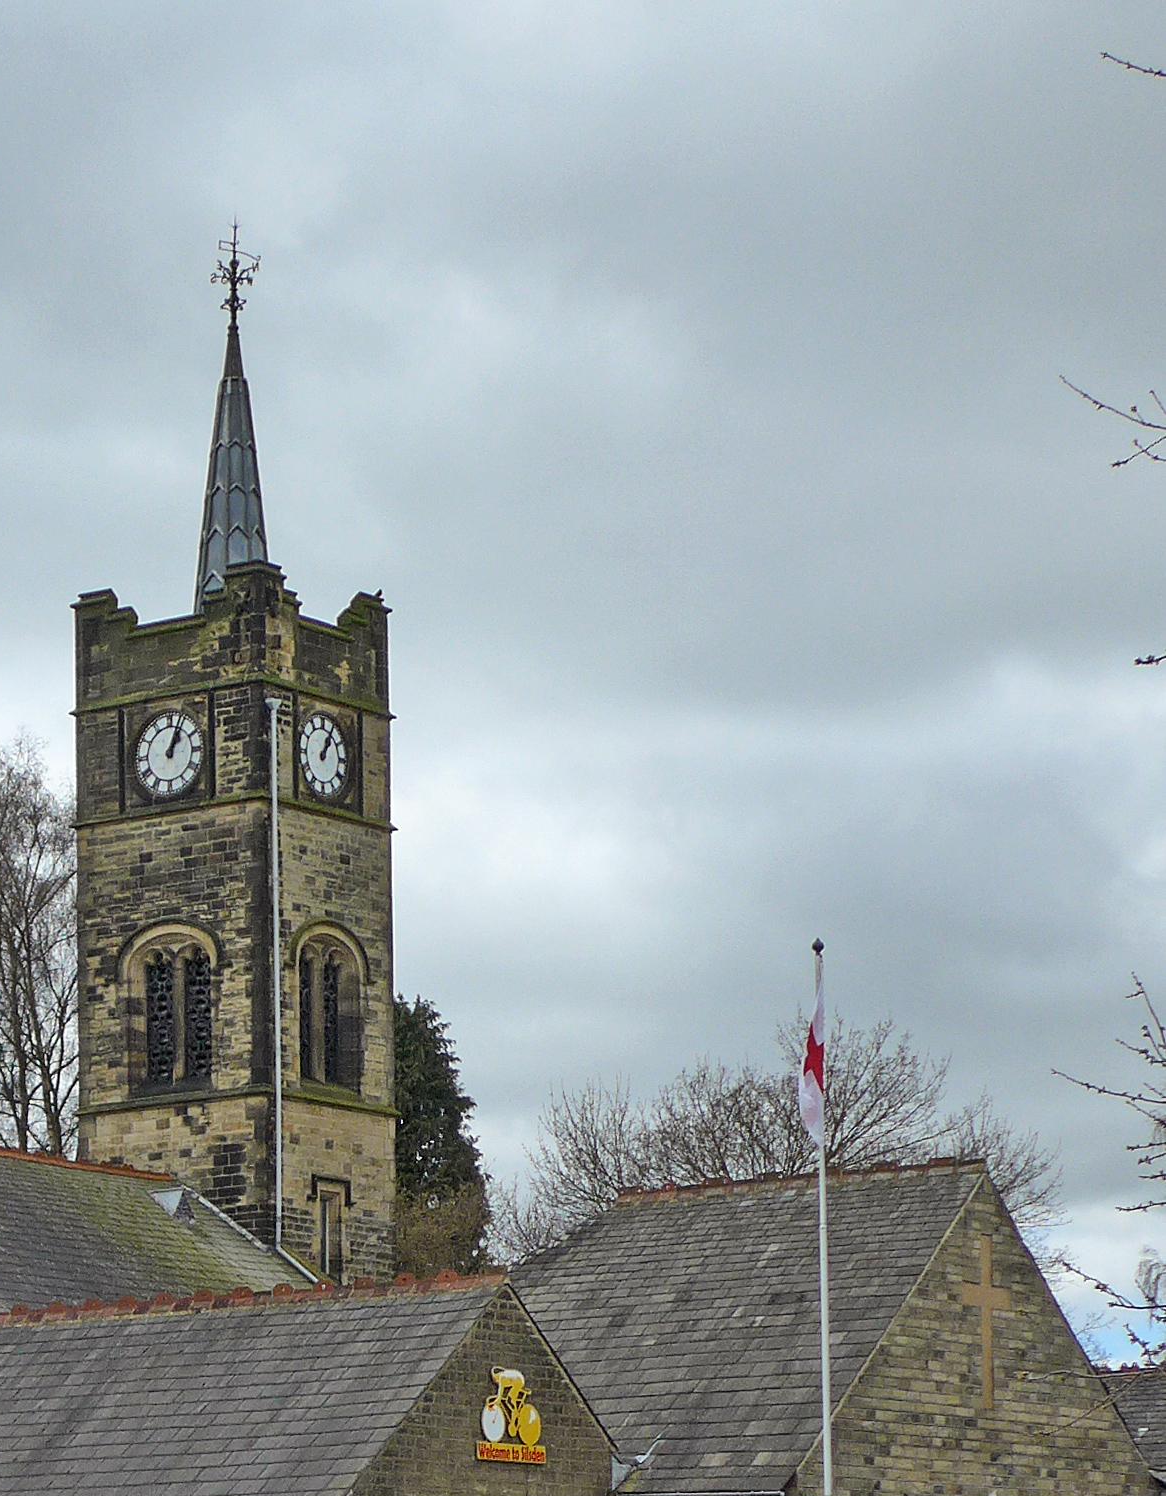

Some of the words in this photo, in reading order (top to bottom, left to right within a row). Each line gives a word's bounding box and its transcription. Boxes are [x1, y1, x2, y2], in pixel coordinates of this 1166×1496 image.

[479, 1443, 510, 1460] Welcome
[512, 1446, 520, 1461] to
[521, 1446, 545, 1463] Silsden
